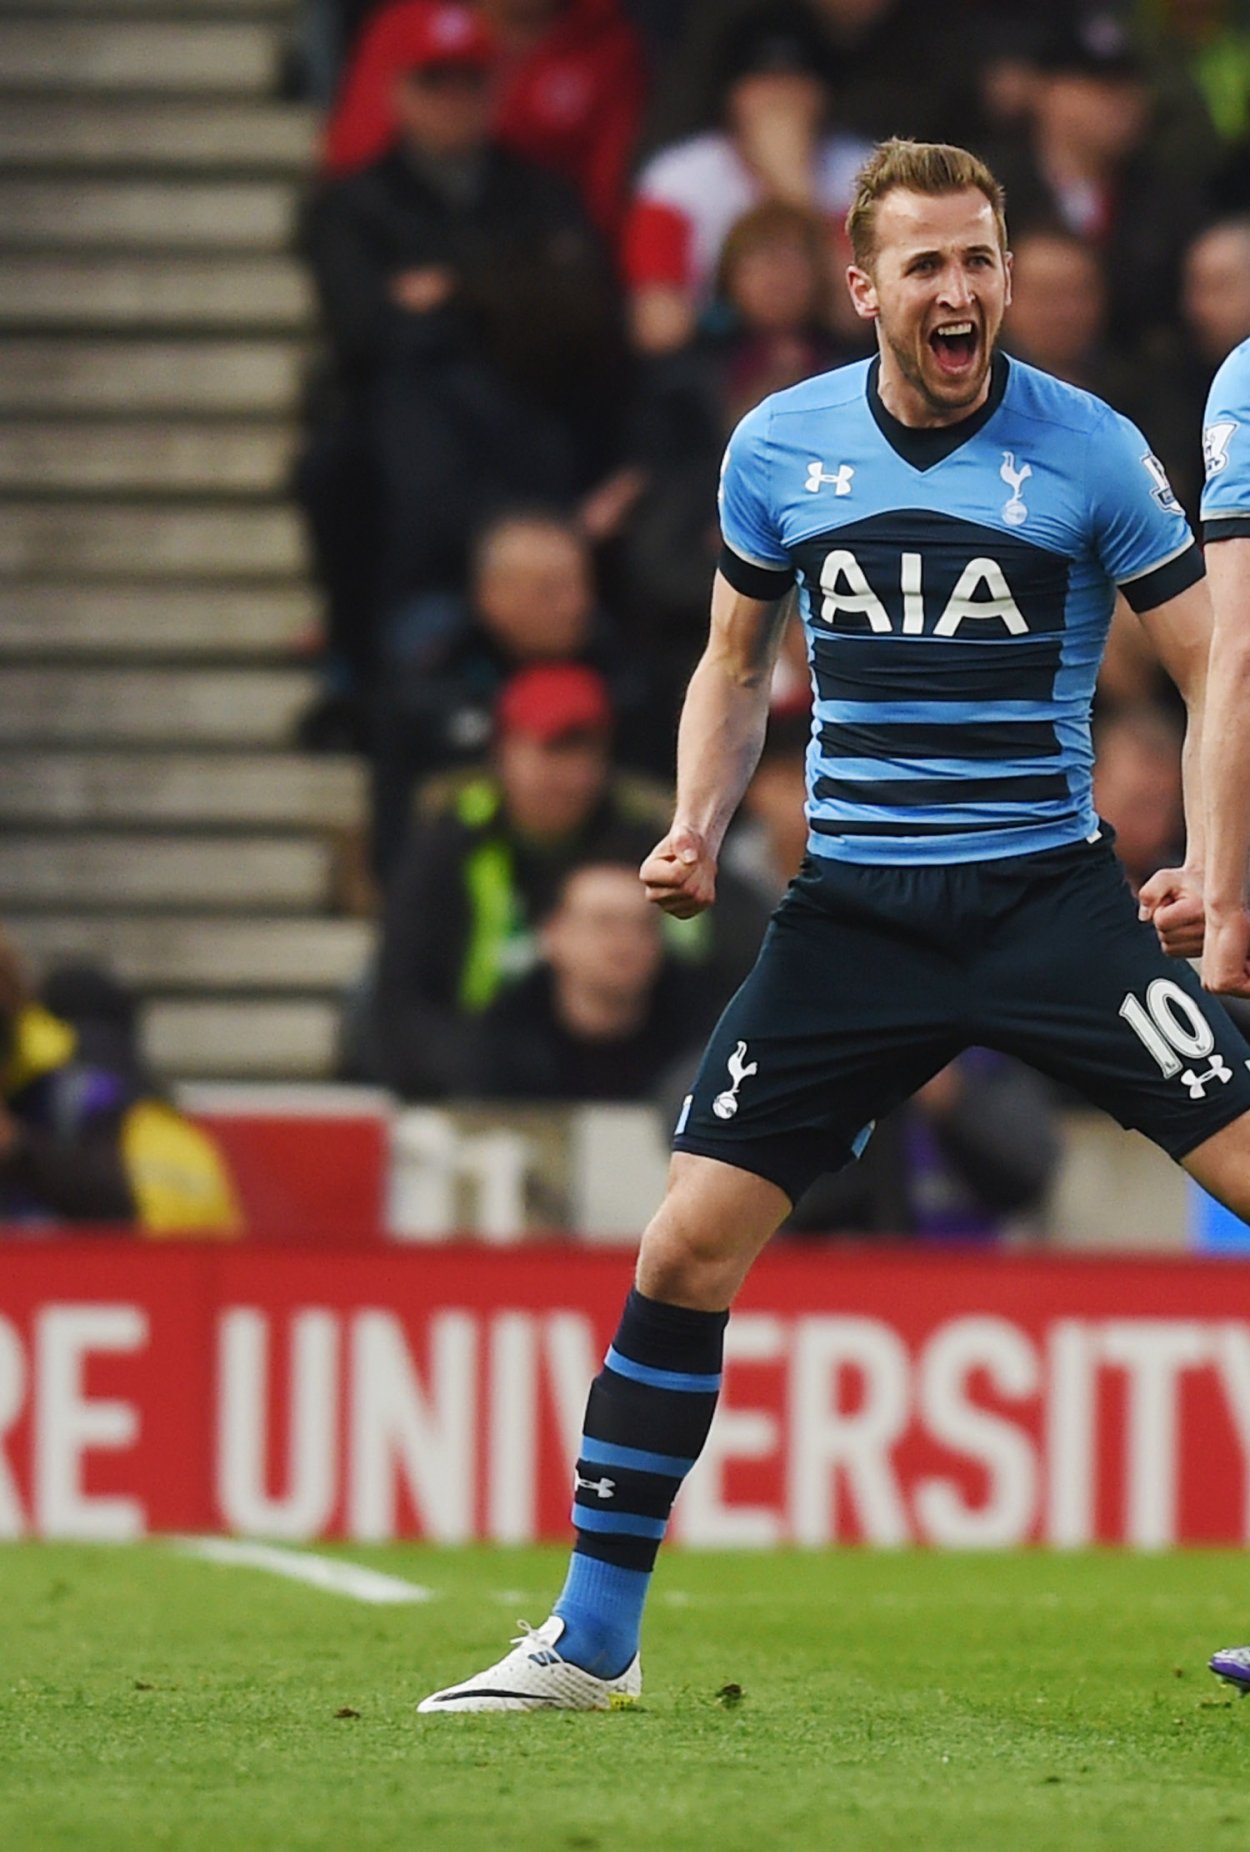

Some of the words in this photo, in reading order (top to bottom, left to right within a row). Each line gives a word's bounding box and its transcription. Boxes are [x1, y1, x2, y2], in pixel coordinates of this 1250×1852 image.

[820, 549, 1030, 637] AIA
[1118, 977, 1216, 1080] 10
[0, 1302, 148, 1543] E
